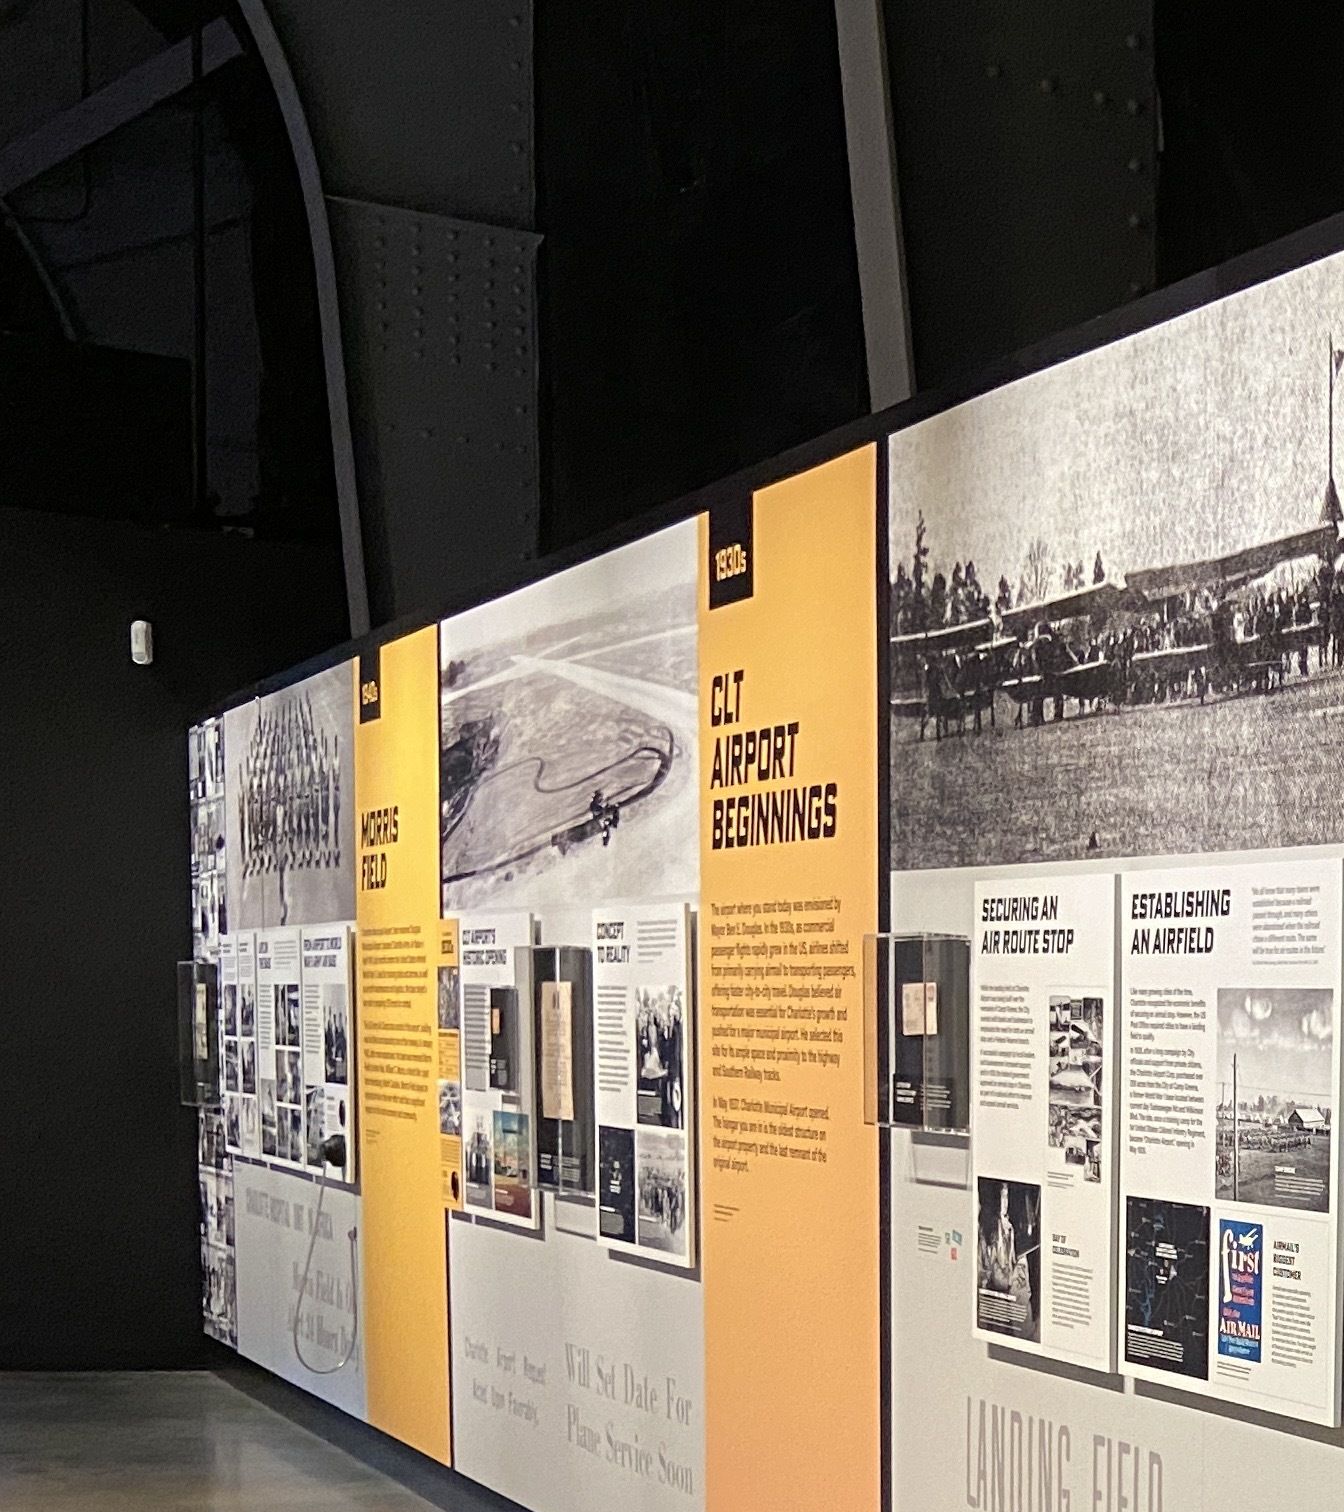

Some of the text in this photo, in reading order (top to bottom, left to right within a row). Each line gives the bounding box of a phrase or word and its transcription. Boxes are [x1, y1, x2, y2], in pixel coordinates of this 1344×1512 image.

[715, 543, 747, 582] 1930s
[710, 669, 745, 728] CLT
[710, 721, 800, 790] AIRPORT
[361, 805, 399, 850] MORRIS
[711, 782, 838, 850] BEGINNINGS
[361, 852, 388, 892] FIELD
[981, 895, 1058, 922] SECURING AN
[1130, 889, 1231, 920] ESTABLISHING
[981, 928, 1074, 955] AIR ROUTE STOP
[1131, 926, 1214, 955] AN AIRFIELD
[1221, 1228, 1260, 1304] first
[565, 1342, 590, 1389] Will
[624, 1363, 658, 1414] Date
[666, 1377, 692, 1426] For
[606, 1421, 653, 1477] Service
[658, 1441, 694, 1495] Soon
